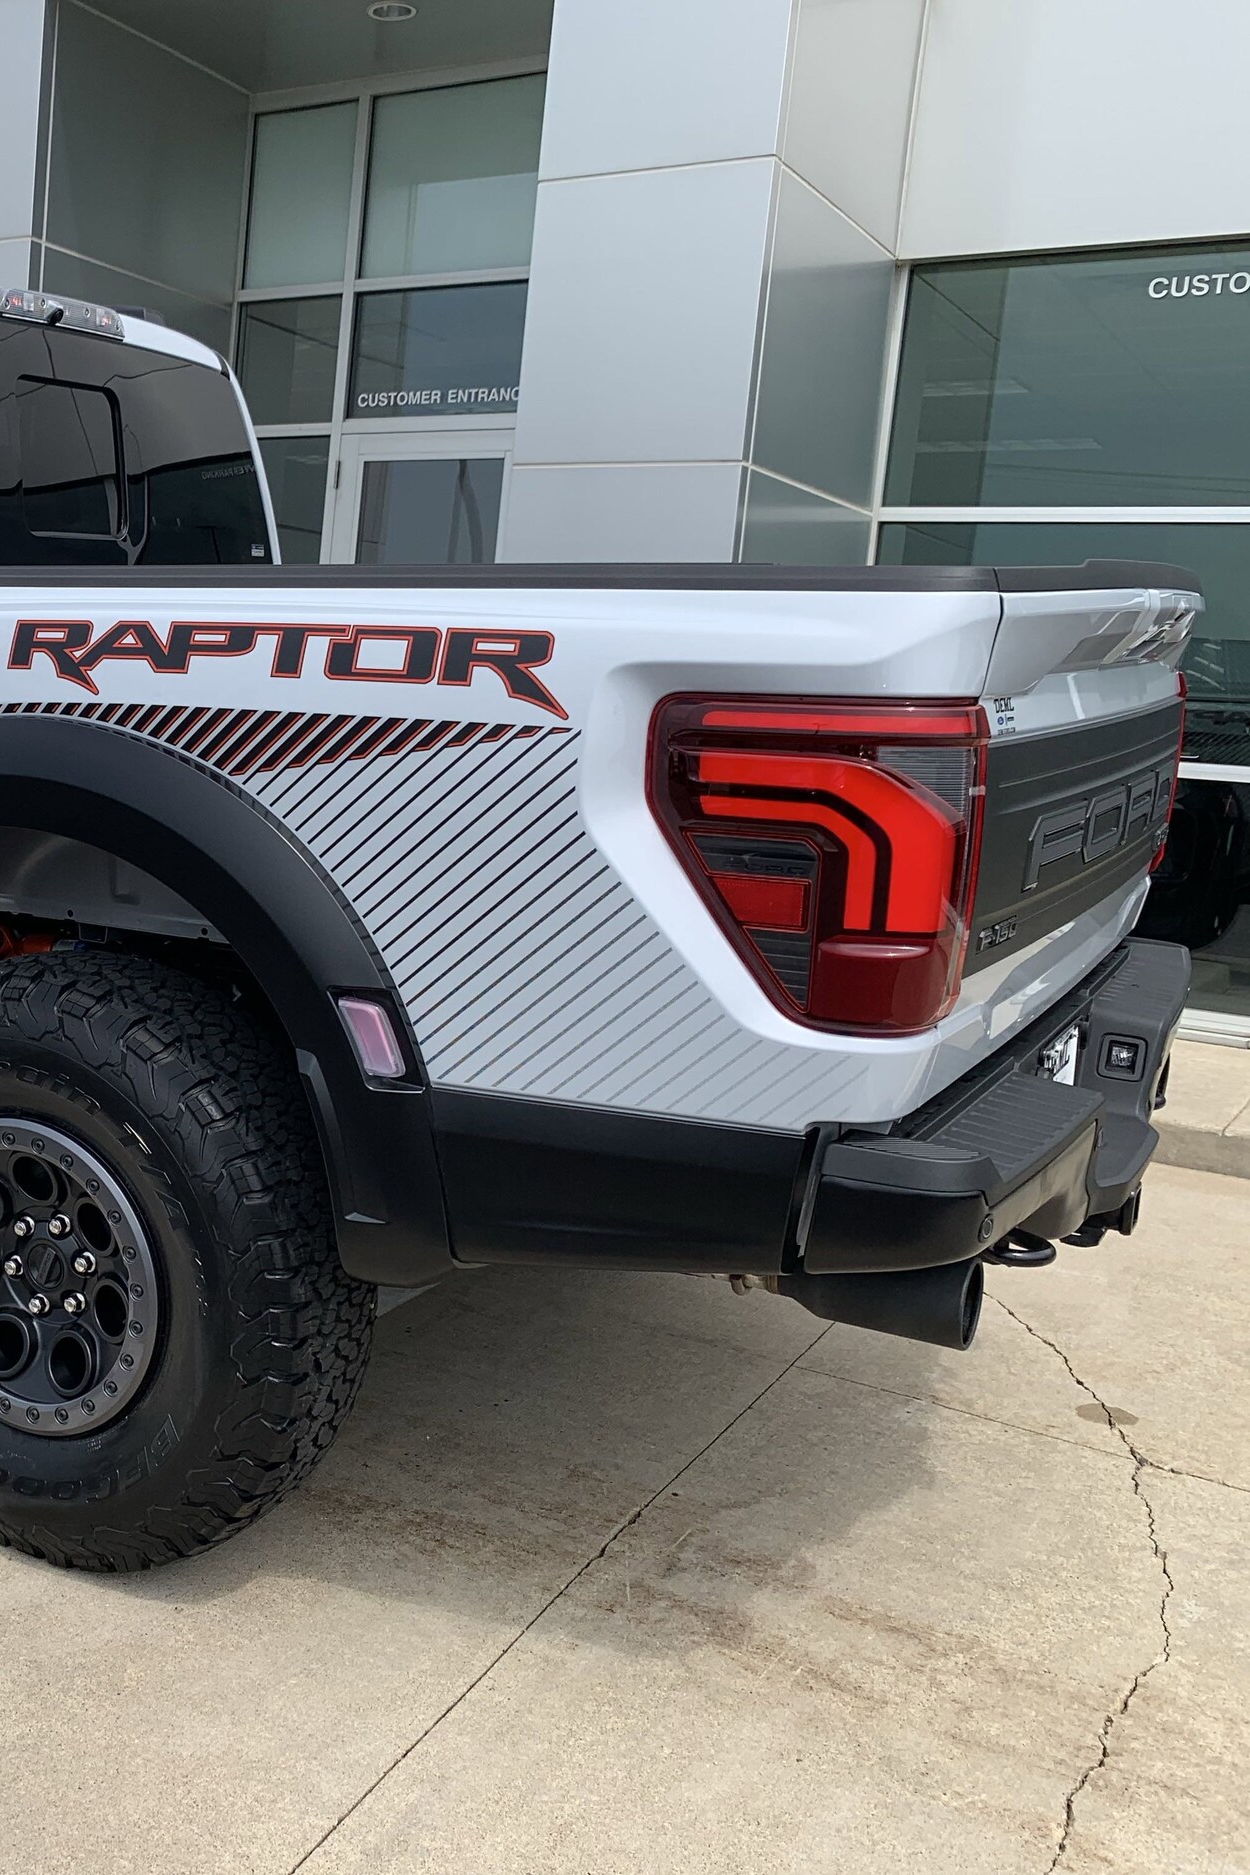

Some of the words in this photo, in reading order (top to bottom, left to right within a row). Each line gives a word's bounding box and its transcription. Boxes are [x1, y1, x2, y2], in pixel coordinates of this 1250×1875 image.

[1148, 271, 1250, 299] CUSTO
[357, 390, 441, 408] CUSTOMER
[7, 619, 570, 721] RAPTOR
[1021, 762, 1173, 893] FORD
[977, 916, 1017, 952] F-150
